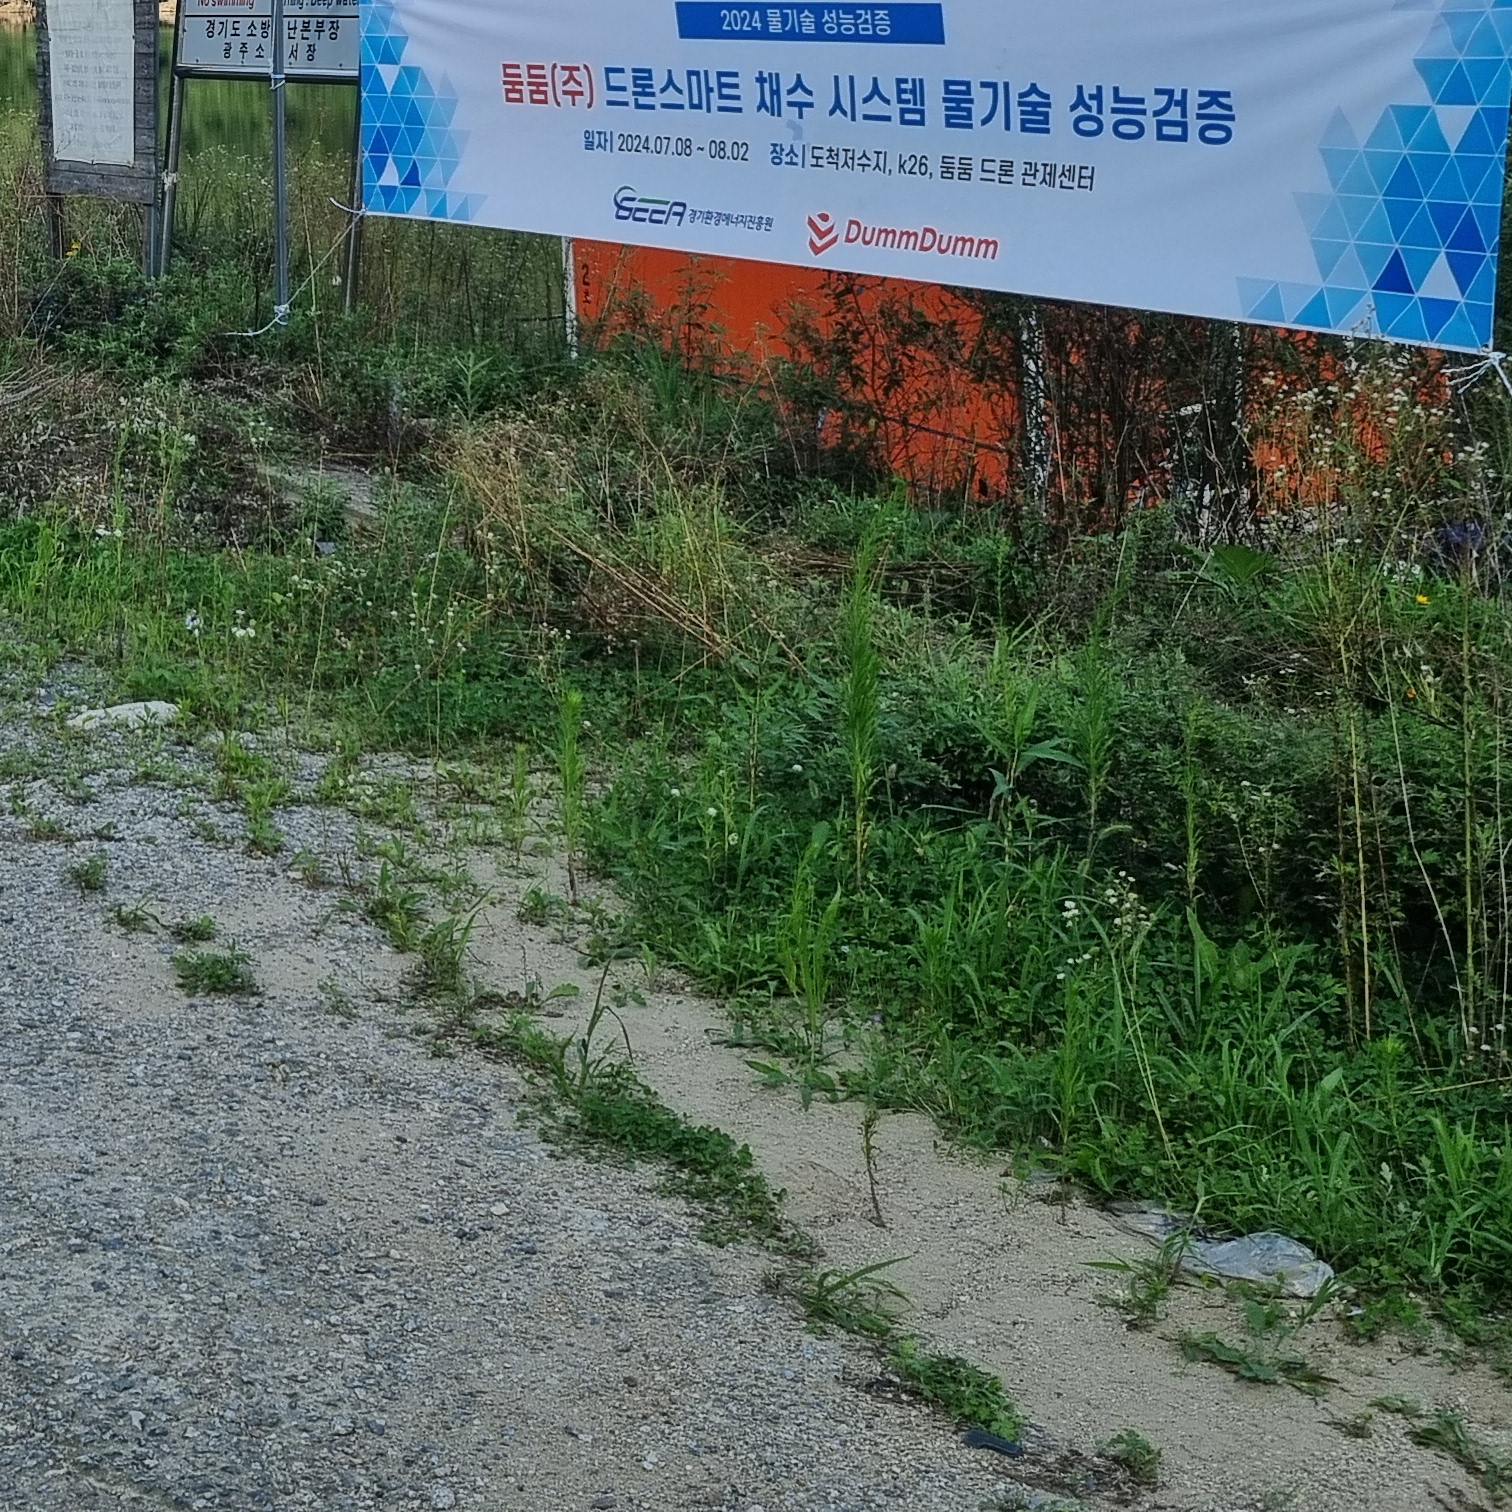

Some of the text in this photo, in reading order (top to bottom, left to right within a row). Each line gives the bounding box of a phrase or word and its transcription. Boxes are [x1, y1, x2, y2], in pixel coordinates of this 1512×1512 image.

[205, 19, 241, 39] 경기도
[720, 9, 891, 36] 2024 물기술 성능검증
[501, 62, 1237, 146] 둠둠(주) 드론스마트 채수 시스템 물기술 성능검증
[617, 133, 693, 158] 2024.07.08
[708, 139, 750, 162] 08.02
[809, 145, 893, 177] 도척저수지,
[897, 152, 934, 180] k26,
[939, 154, 974, 182] 둠둠
[979, 158, 1016, 186] 드론
[1020, 160, 1096, 193] 관제센터
[688, 208, 775, 232] 경기환경에너지진흥원
[844, 218, 1000, 261] DummDumm
